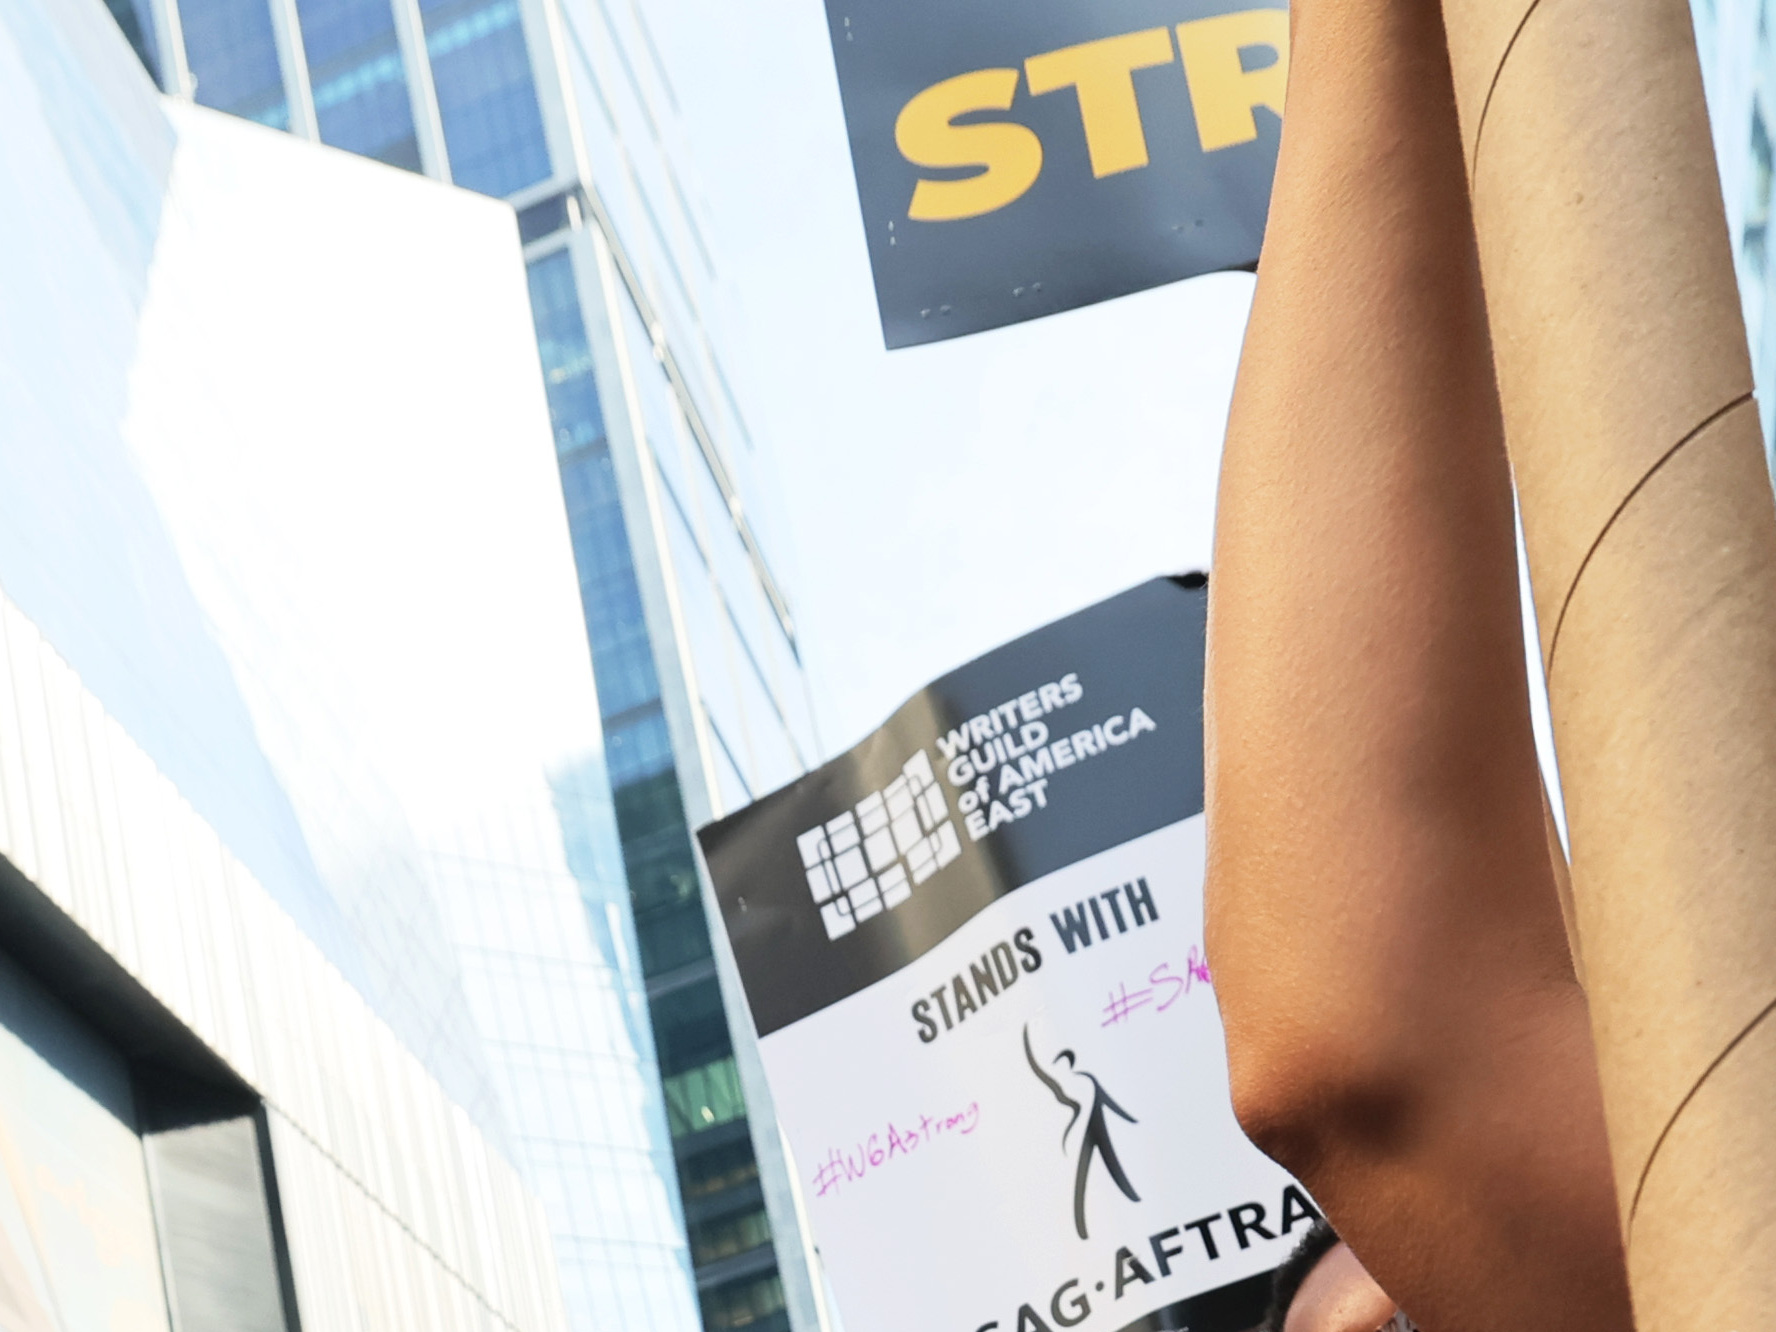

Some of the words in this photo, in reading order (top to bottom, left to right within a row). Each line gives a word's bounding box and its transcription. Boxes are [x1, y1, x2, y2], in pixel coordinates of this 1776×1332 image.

[935, 672, 1084, 760] WRITERS
[947, 721, 1049, 787] GUILD
[958, 775, 990, 814] of
[999, 707, 1157, 795] AMERICA
[964, 778, 1048, 842] EAST
[911, 926, 1042, 1044] STANDS
[1050, 876, 1161, 955] WITH
